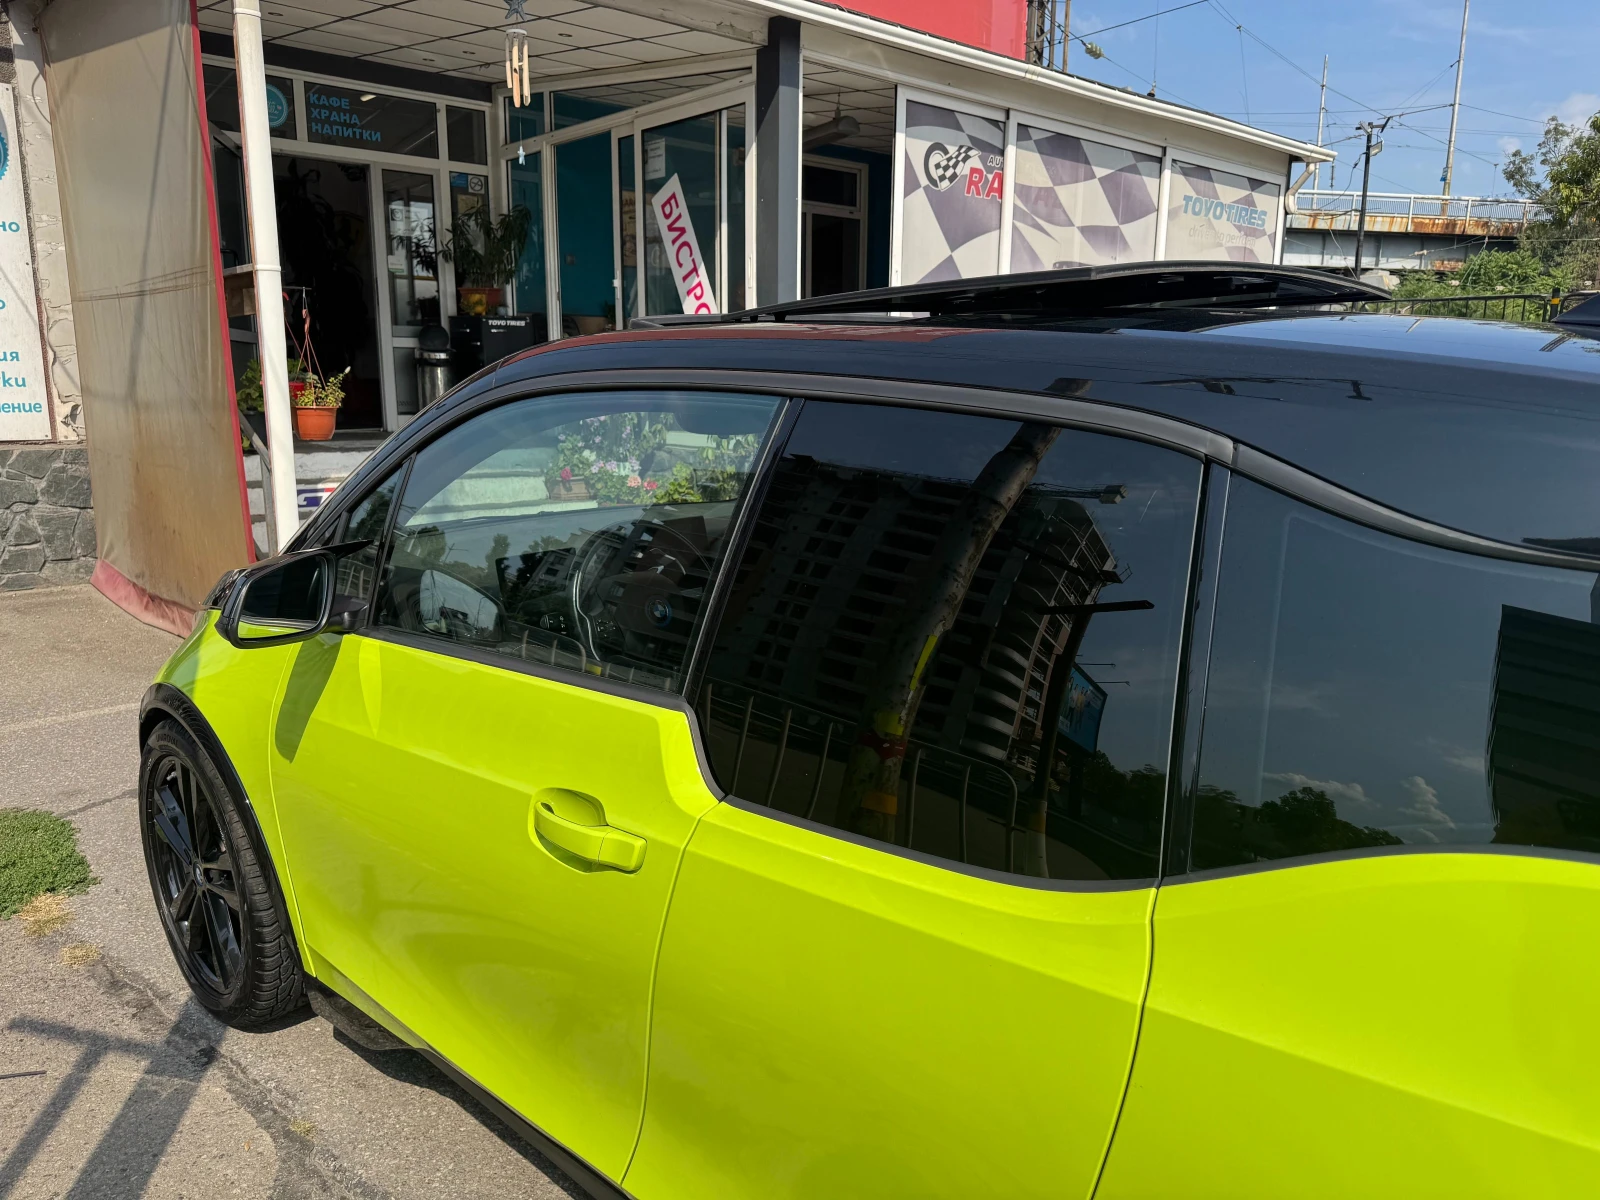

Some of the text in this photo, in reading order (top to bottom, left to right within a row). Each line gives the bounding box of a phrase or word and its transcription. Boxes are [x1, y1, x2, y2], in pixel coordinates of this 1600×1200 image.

[309, 93, 350, 109] КАФЕ
[310, 108, 361, 126] ХРАНА
[311, 122, 382, 142] НАПИТКИ
[987, 155, 1004, 167] AU
[1183, 194, 1268, 230] TOYO TIRES
[0, 371, 27, 388] ки
[0, 402, 42, 413] ение
